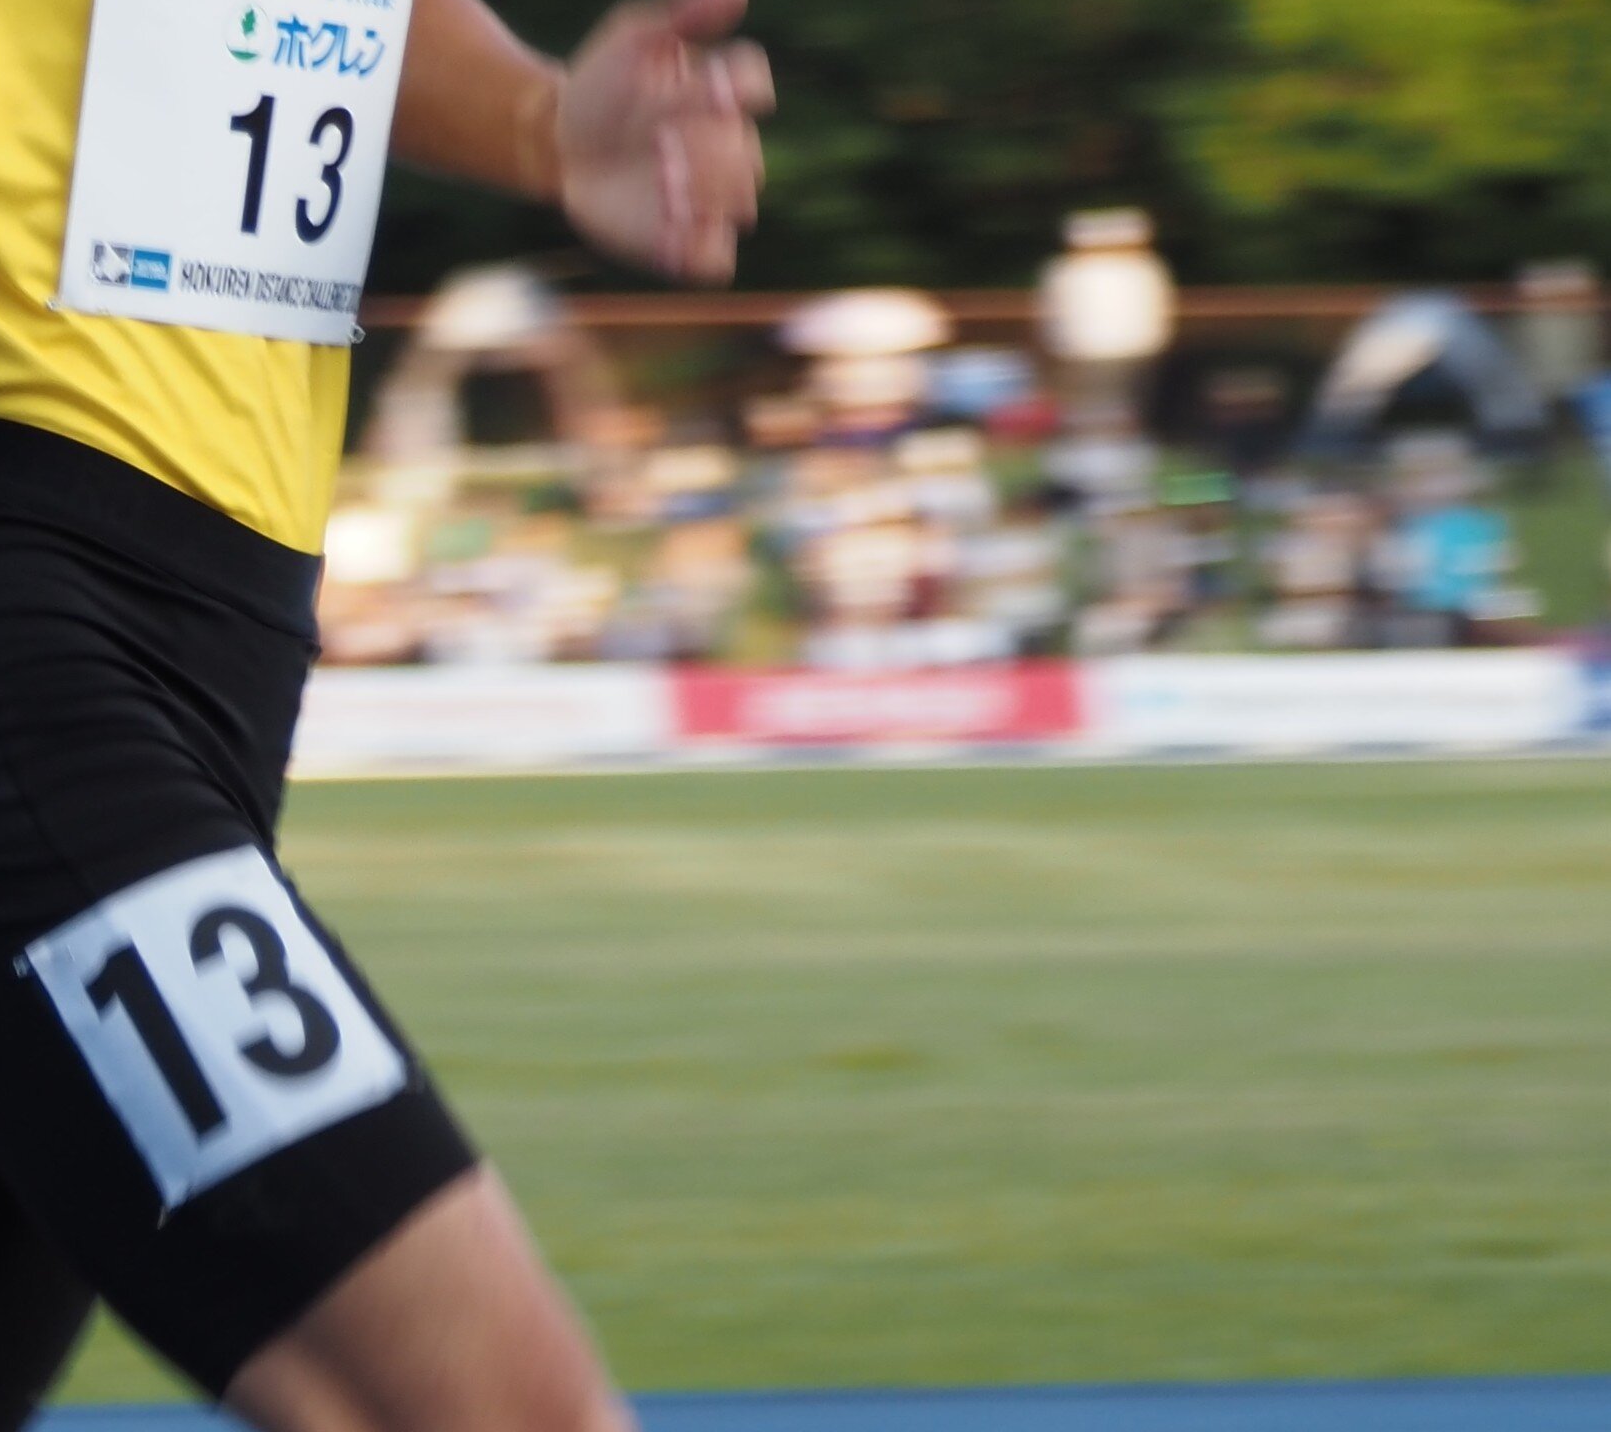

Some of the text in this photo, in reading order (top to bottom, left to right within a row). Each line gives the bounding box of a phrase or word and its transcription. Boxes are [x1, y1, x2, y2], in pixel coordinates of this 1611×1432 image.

[273, 14, 386, 76] ホクレン
[229, 94, 355, 244] 13
[84, 905, 342, 1141] 13
